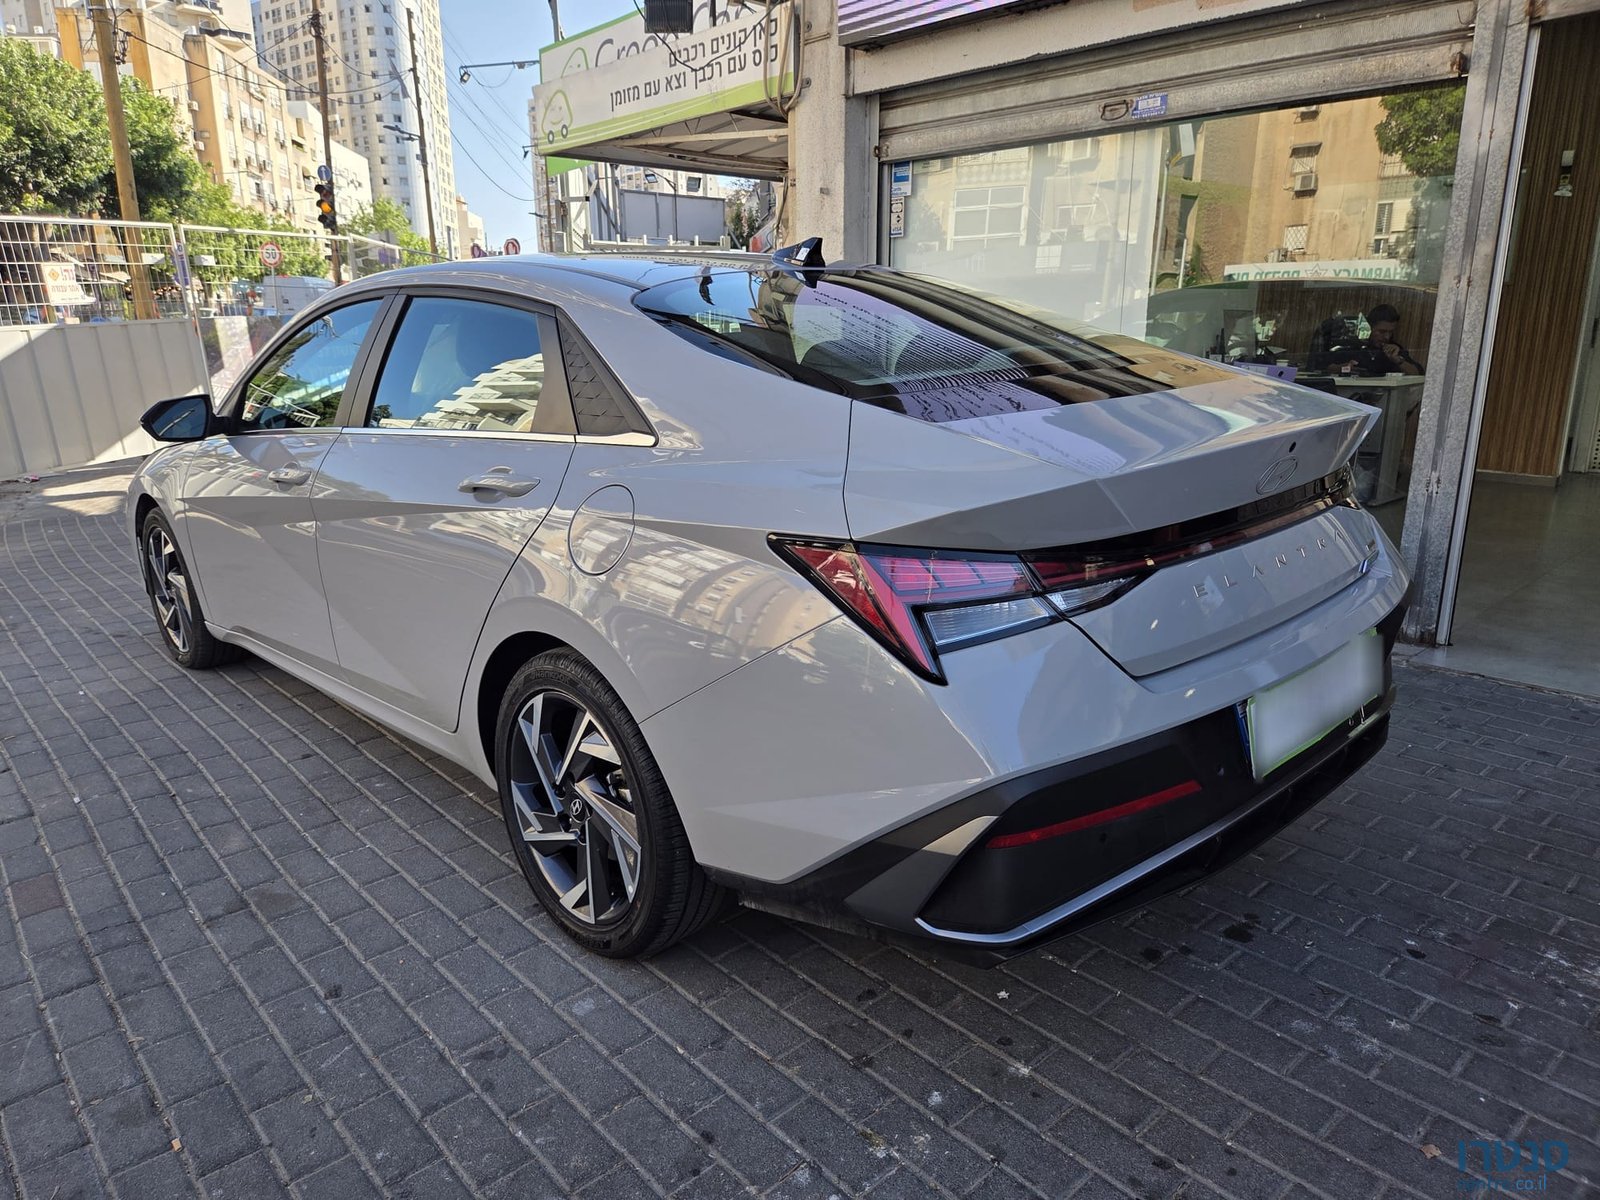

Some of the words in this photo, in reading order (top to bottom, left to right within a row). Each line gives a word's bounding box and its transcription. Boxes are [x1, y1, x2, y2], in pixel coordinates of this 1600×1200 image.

[711, 28, 748, 55] קונים
[668, 41, 706, 68] רכבים
[727, 55, 747, 74] עם
[752, 44, 778, 67] כס
[644, 79, 661, 97] עם
[665, 72, 687, 92] וצא
[690, 62, 723, 90] רכבך
[610, 86, 640, 112] מזומן
[265, 248, 277, 260] 50
[1192, 530, 1343, 599] ELANTRA
